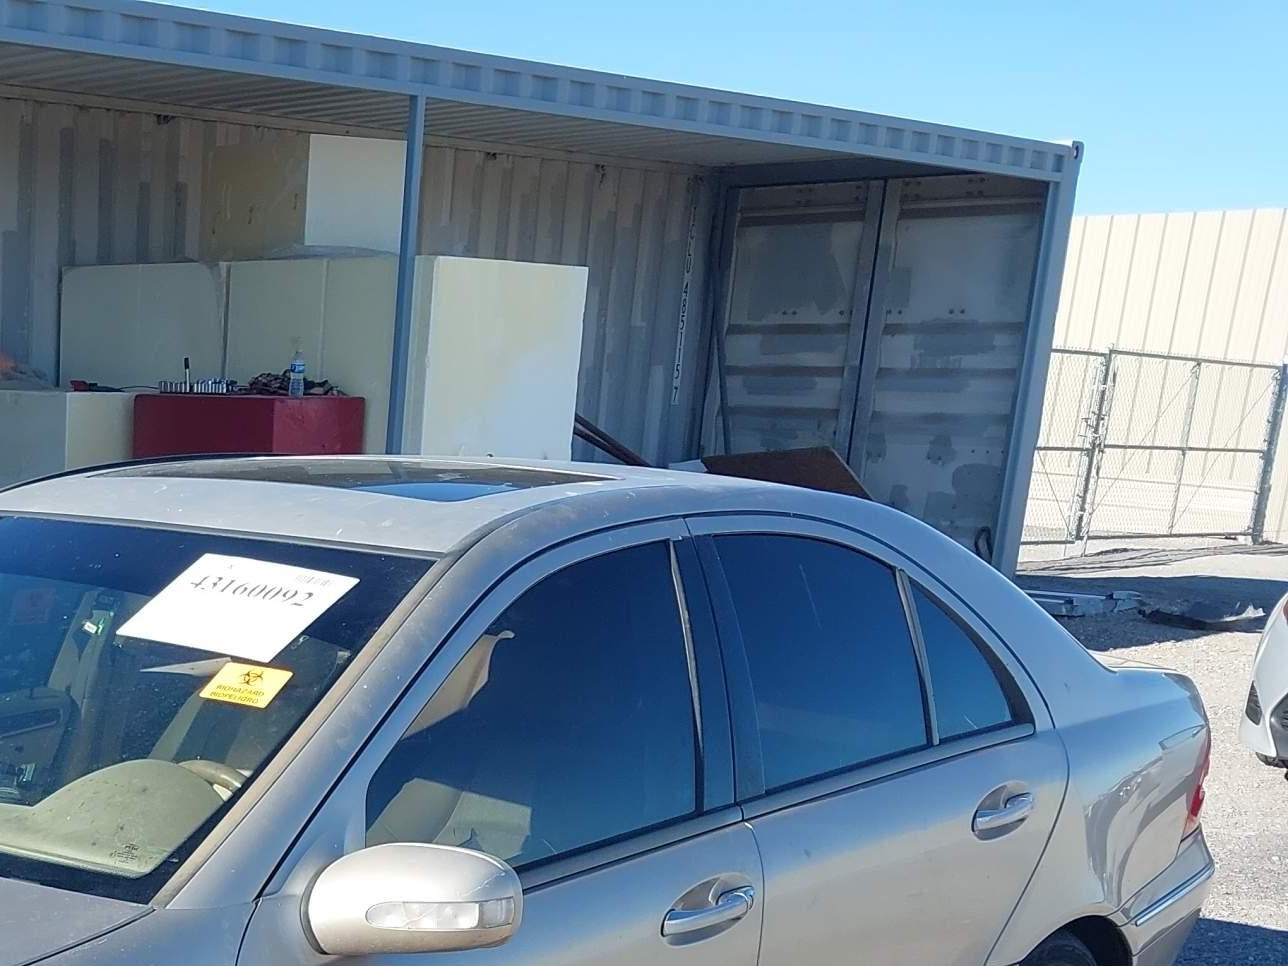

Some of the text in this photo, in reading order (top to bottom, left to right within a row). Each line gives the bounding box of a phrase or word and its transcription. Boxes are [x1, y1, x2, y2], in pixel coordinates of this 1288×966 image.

[190, 575, 314, 607] 43160092
[215, 684, 264, 697] BIOHAZARD
[209, 691, 259, 704] BIOPELIGRO
